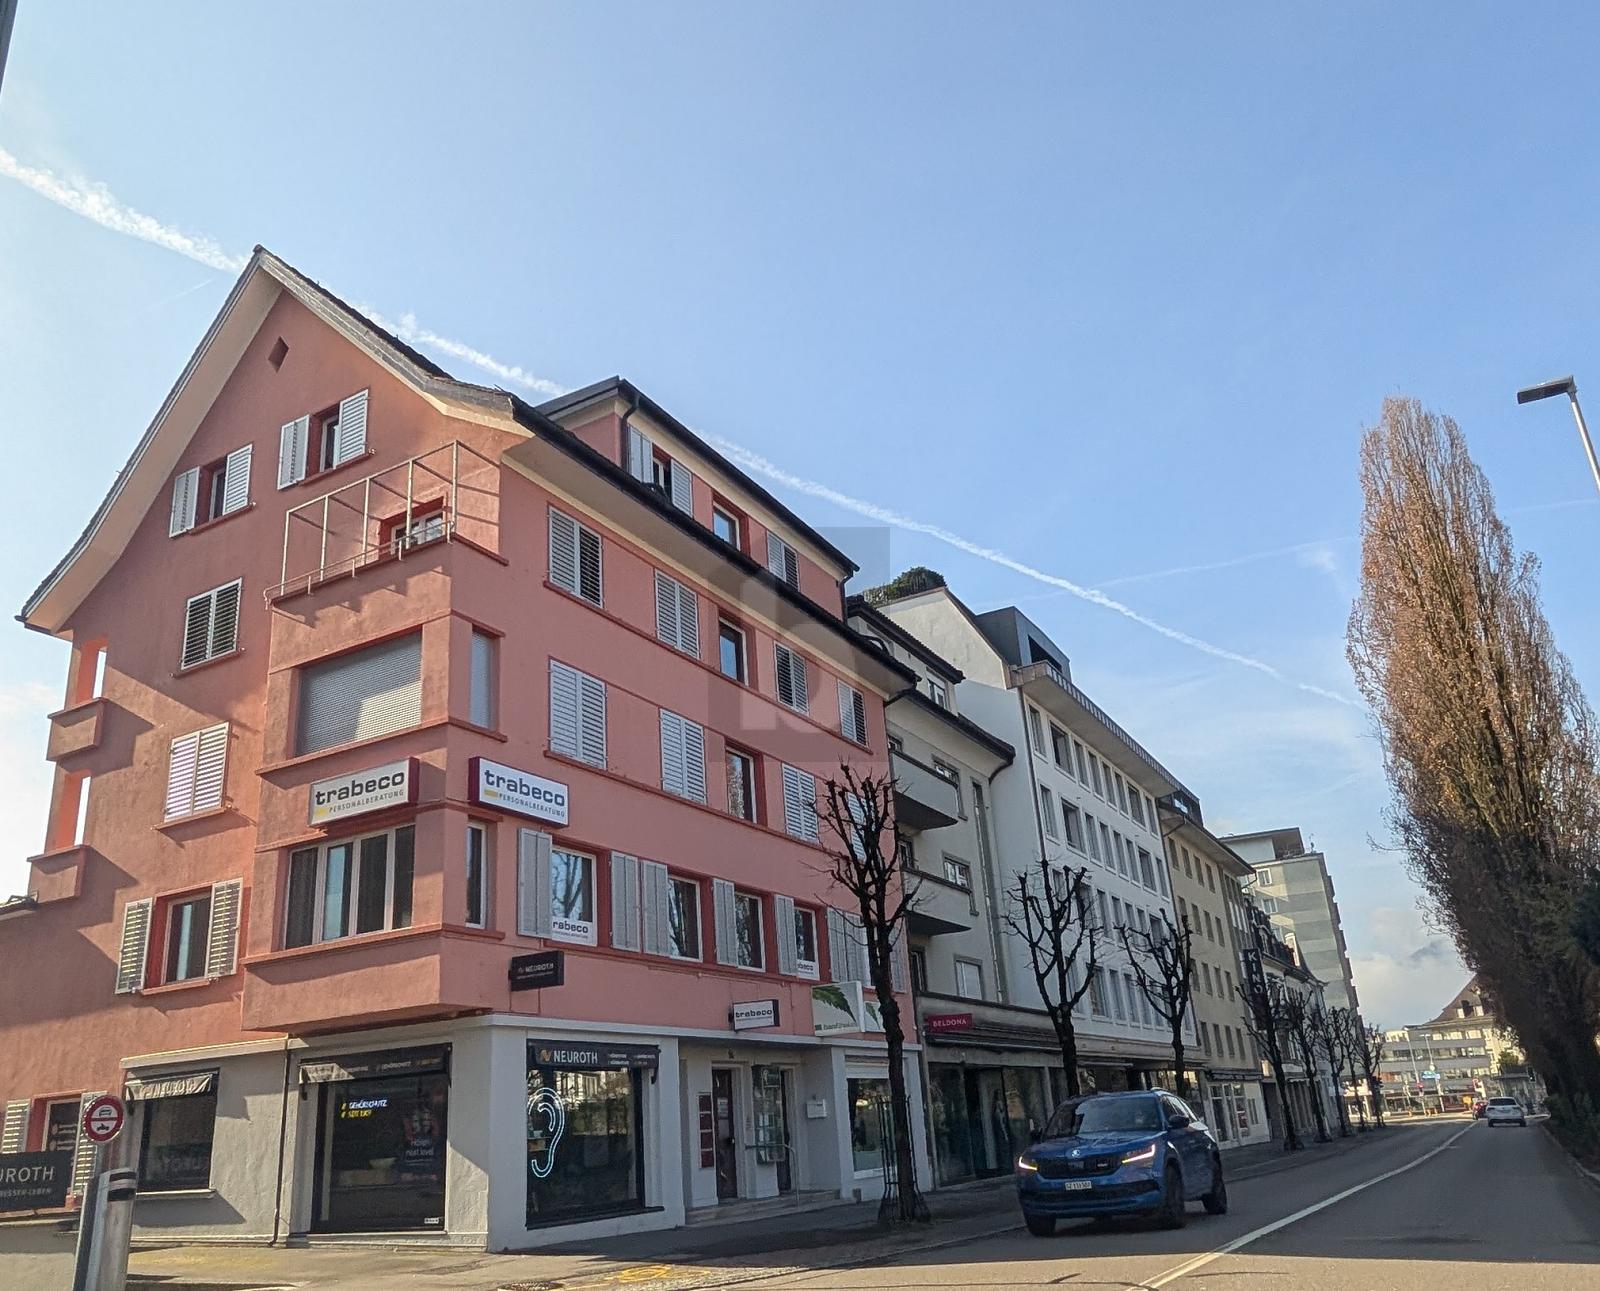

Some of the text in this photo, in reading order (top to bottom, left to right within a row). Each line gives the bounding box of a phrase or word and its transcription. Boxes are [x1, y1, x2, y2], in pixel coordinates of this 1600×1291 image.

[315, 772, 405, 806] trabeco
[484, 769, 565, 807] trabeco
[328, 789, 404, 813] PERSONALBERATUNG
[499, 793, 565, 818] PERSONALBERATUNG
[552, 920, 589, 934] rabeco
[525, 963, 554, 973] NEUROTH
[1247, 951, 1263, 994] KINO
[735, 1010, 773, 1018] trabeco
[933, 1019, 967, 1028] BELDONA
[553, 1050, 598, 1064] NEUROTH
